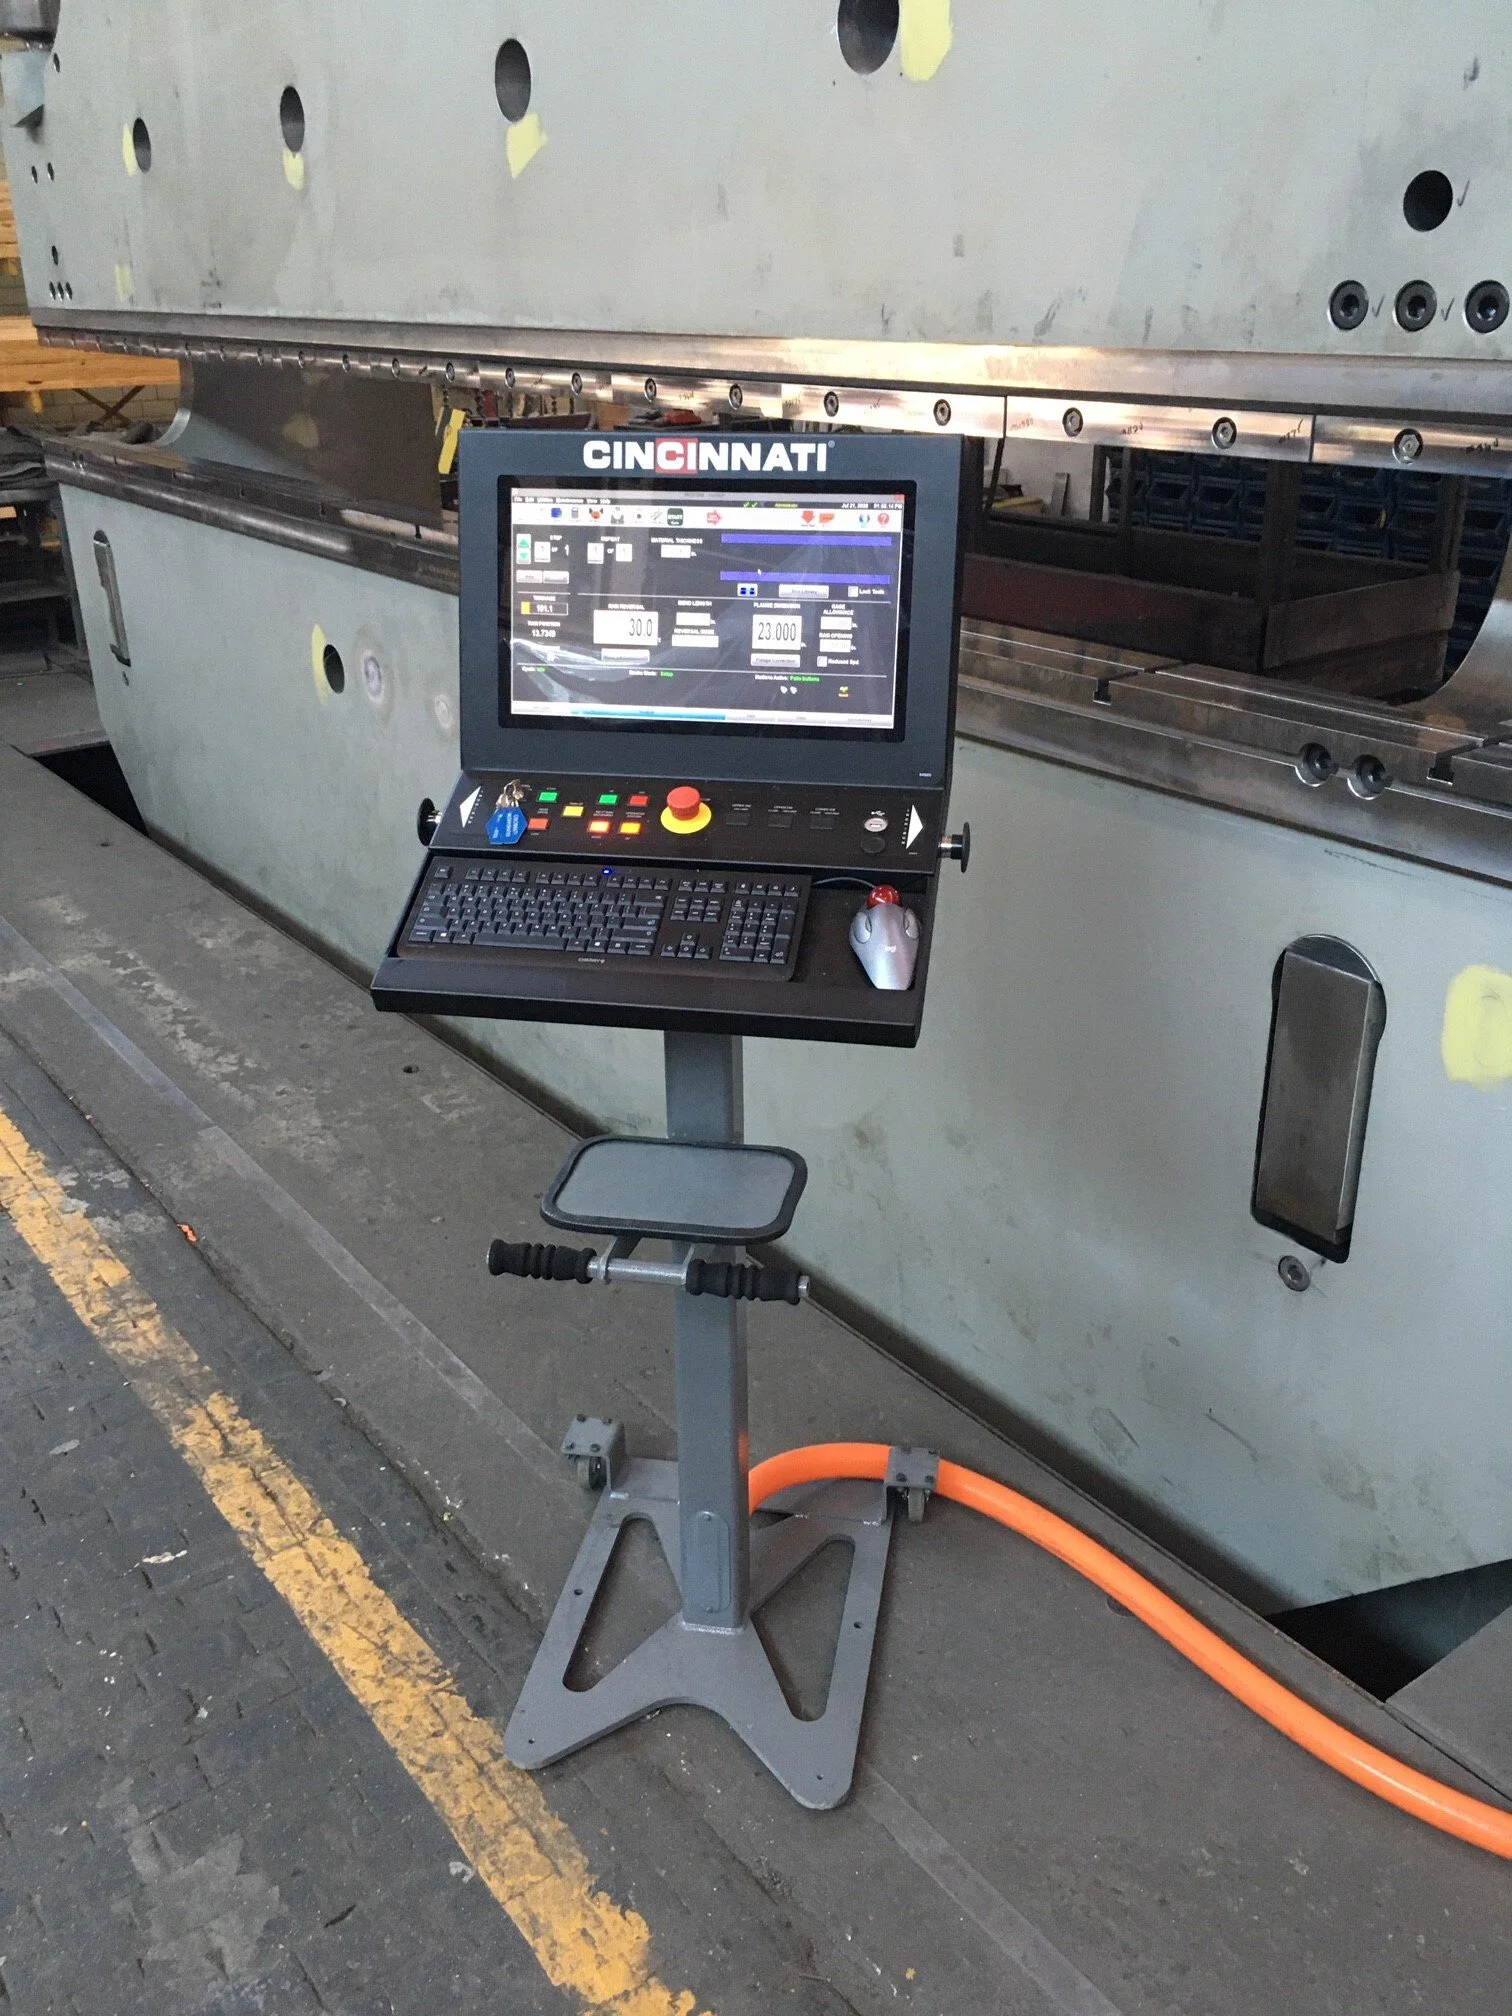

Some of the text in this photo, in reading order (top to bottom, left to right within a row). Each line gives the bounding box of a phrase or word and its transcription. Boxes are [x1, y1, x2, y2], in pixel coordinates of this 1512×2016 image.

[583, 440, 827, 472] CINCINNATI
[629, 618, 653, 637] 30.0
[757, 622, 797, 641] 23.000
